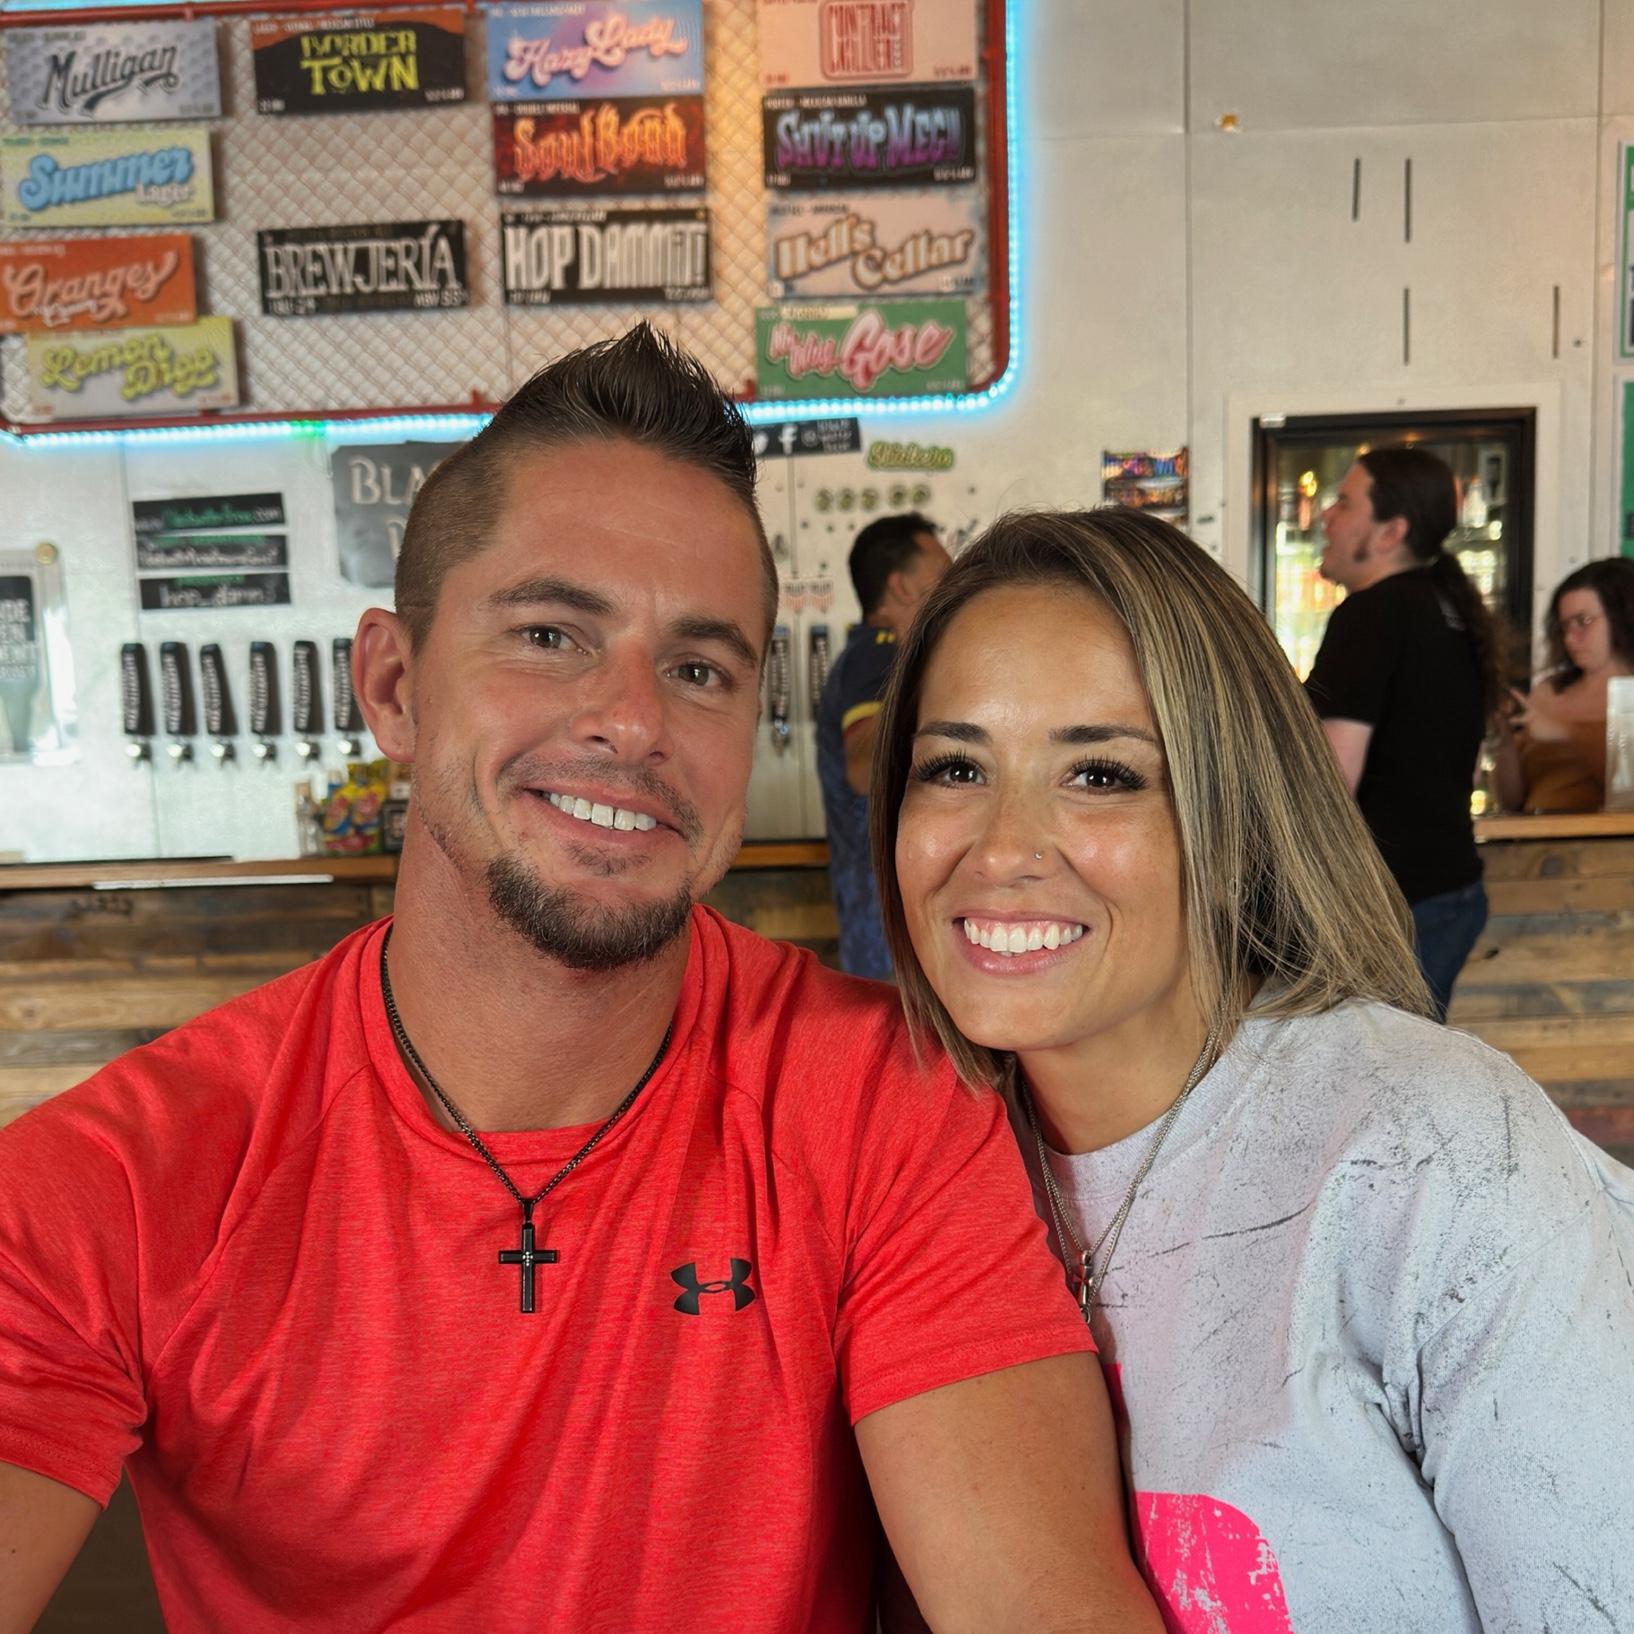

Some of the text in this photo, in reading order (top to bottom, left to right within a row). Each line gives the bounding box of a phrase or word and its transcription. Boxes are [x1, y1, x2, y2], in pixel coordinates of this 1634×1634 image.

[39, 45, 181, 114] Mulligan
[19, 146, 193, 212] Summer
[504, 225, 575, 290] HOP
[350, 455, 441, 505] BLA
